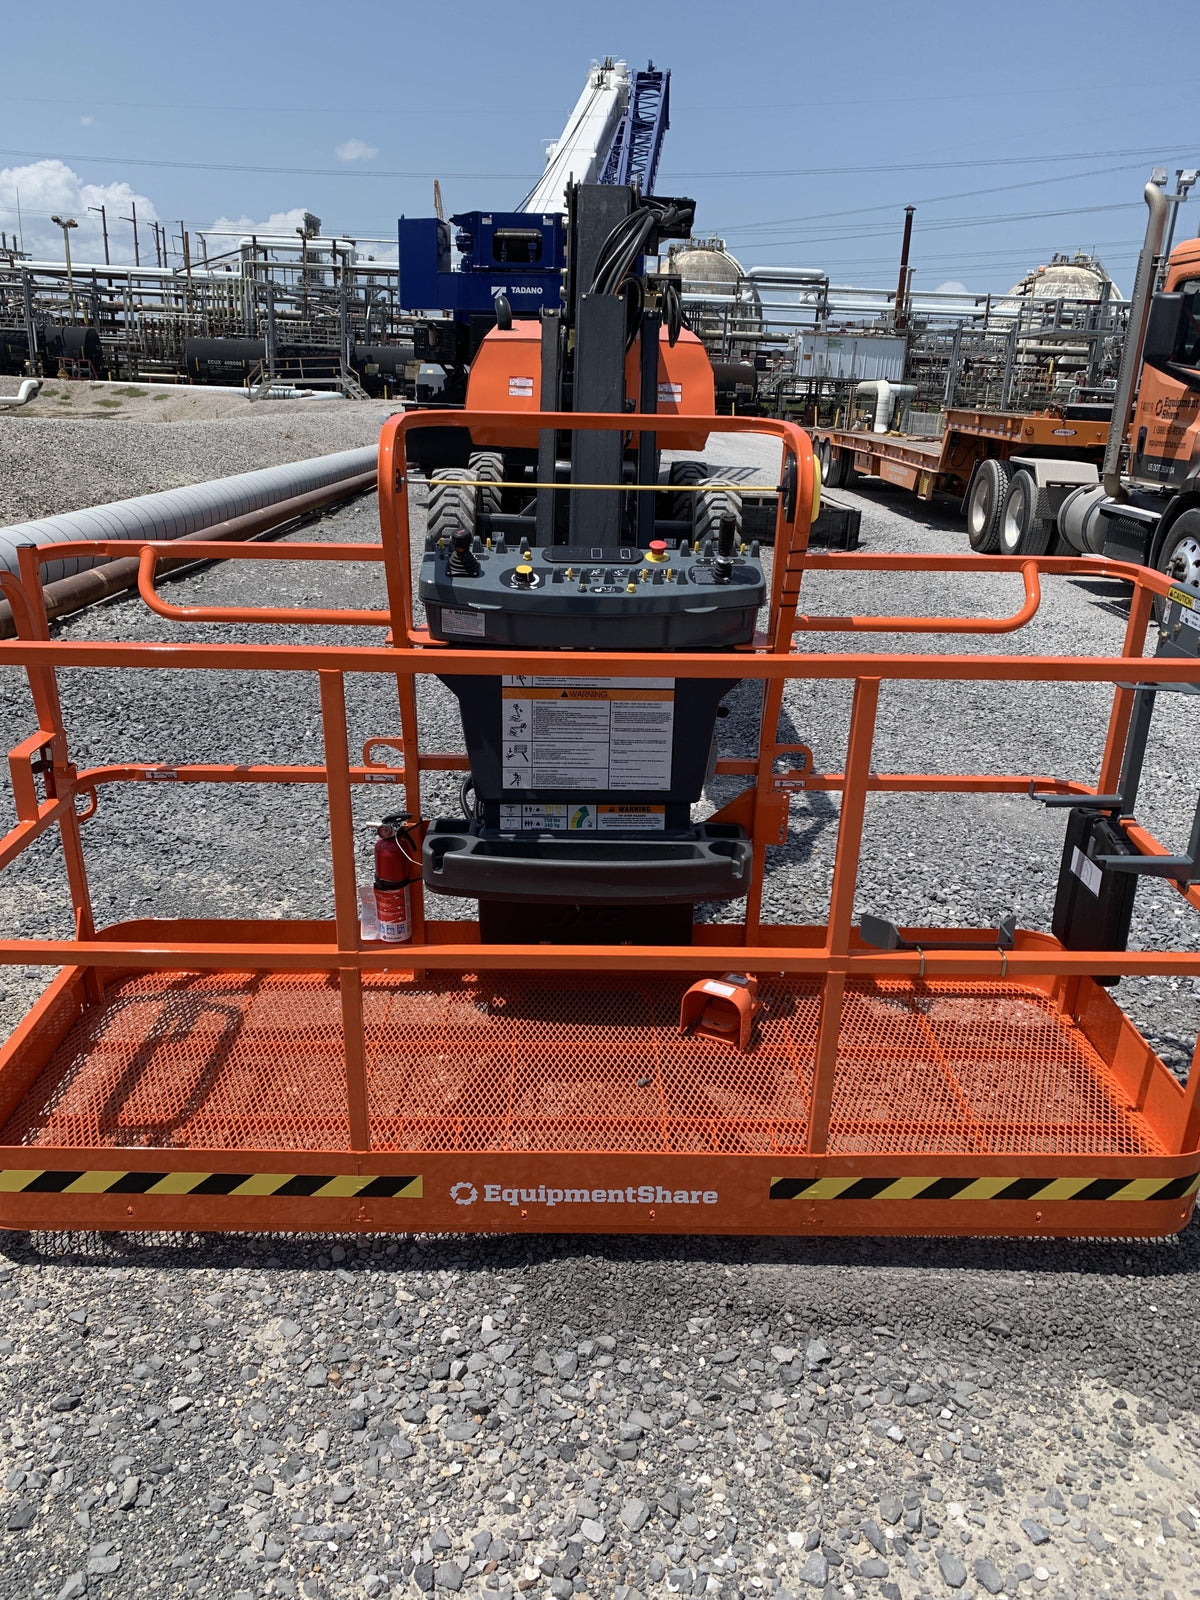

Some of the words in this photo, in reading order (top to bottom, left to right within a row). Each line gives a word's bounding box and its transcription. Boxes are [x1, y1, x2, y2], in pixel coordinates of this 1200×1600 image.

[511, 286, 543, 295] TADANO
[1164, 397, 1200, 409] Equipment
[1162, 409, 1180, 420] Share
[1174, 590, 1192, 606] CAUTION
[570, 690, 608, 699] WARNING
[618, 806, 651, 814] WARNING
[483, 1184, 719, 1207] EquipmentShare
